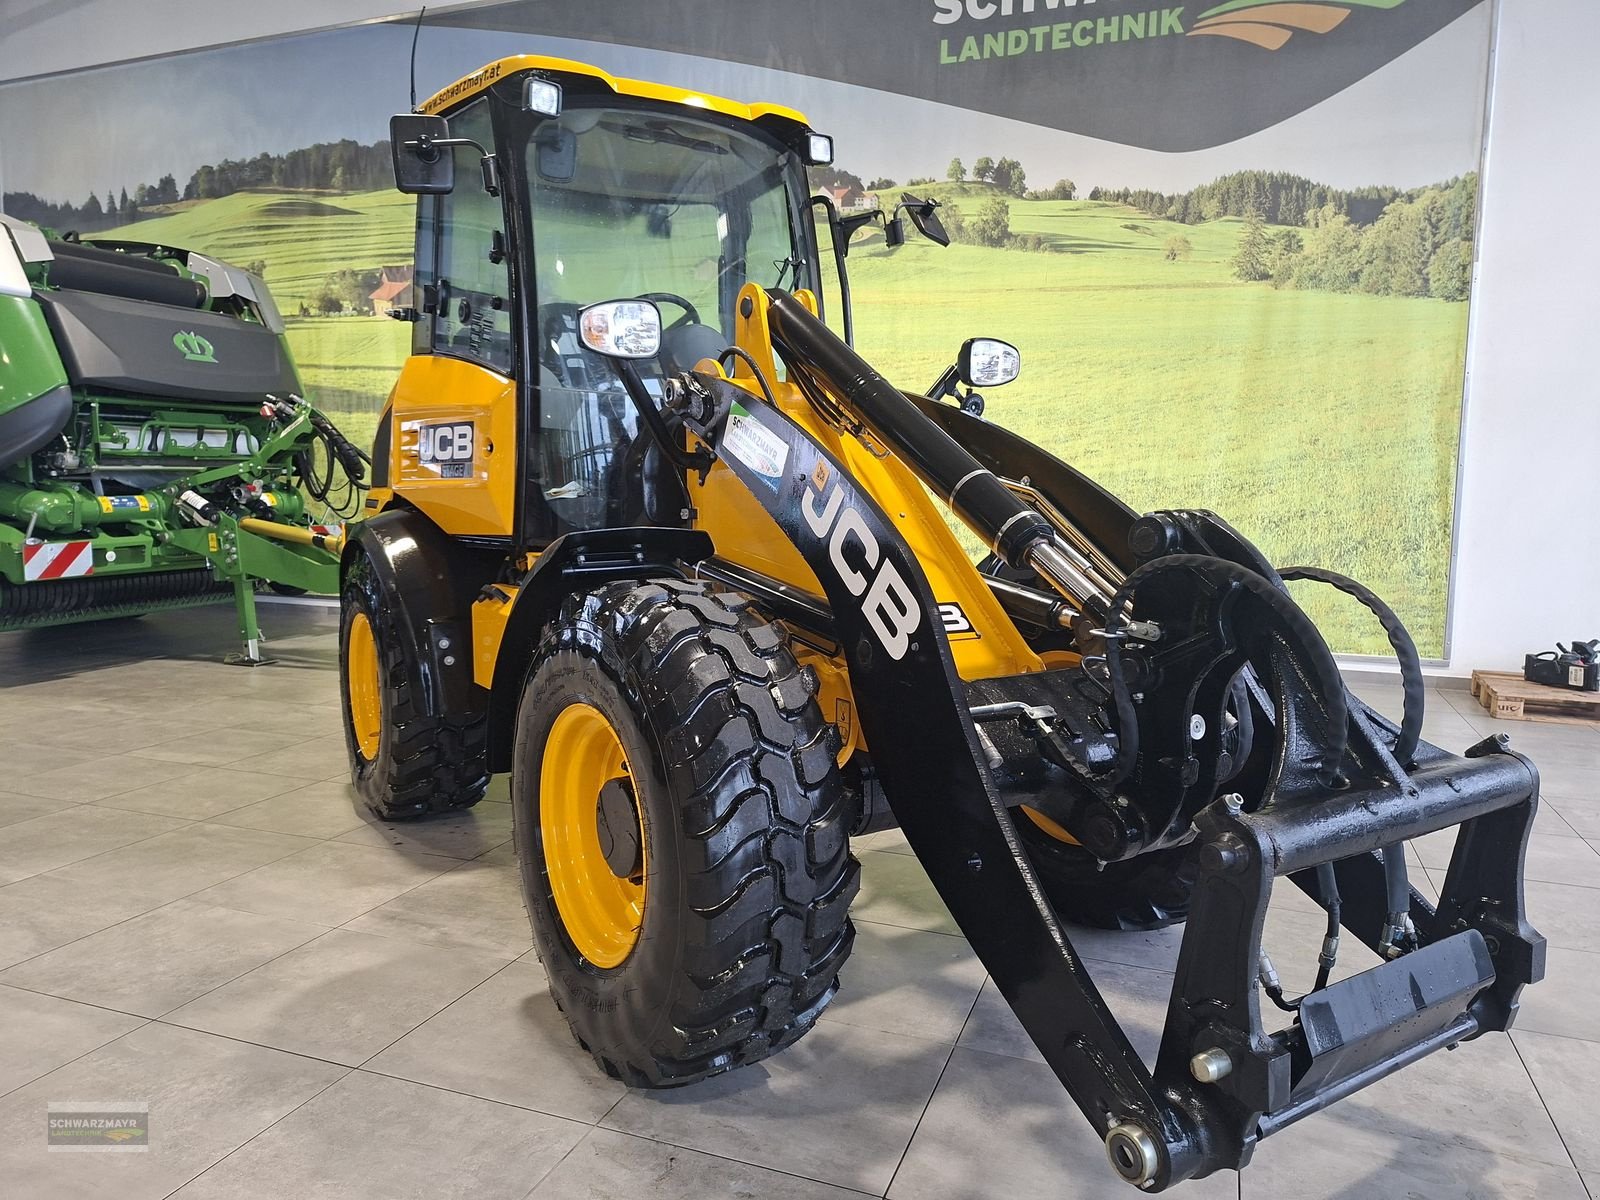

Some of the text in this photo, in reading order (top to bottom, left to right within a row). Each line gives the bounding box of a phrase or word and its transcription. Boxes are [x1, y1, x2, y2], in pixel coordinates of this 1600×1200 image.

[940, 6, 1185, 65] LANDTECHNIK
[420, 425, 473, 461] JCB
[802, 483, 921, 661] JCB
